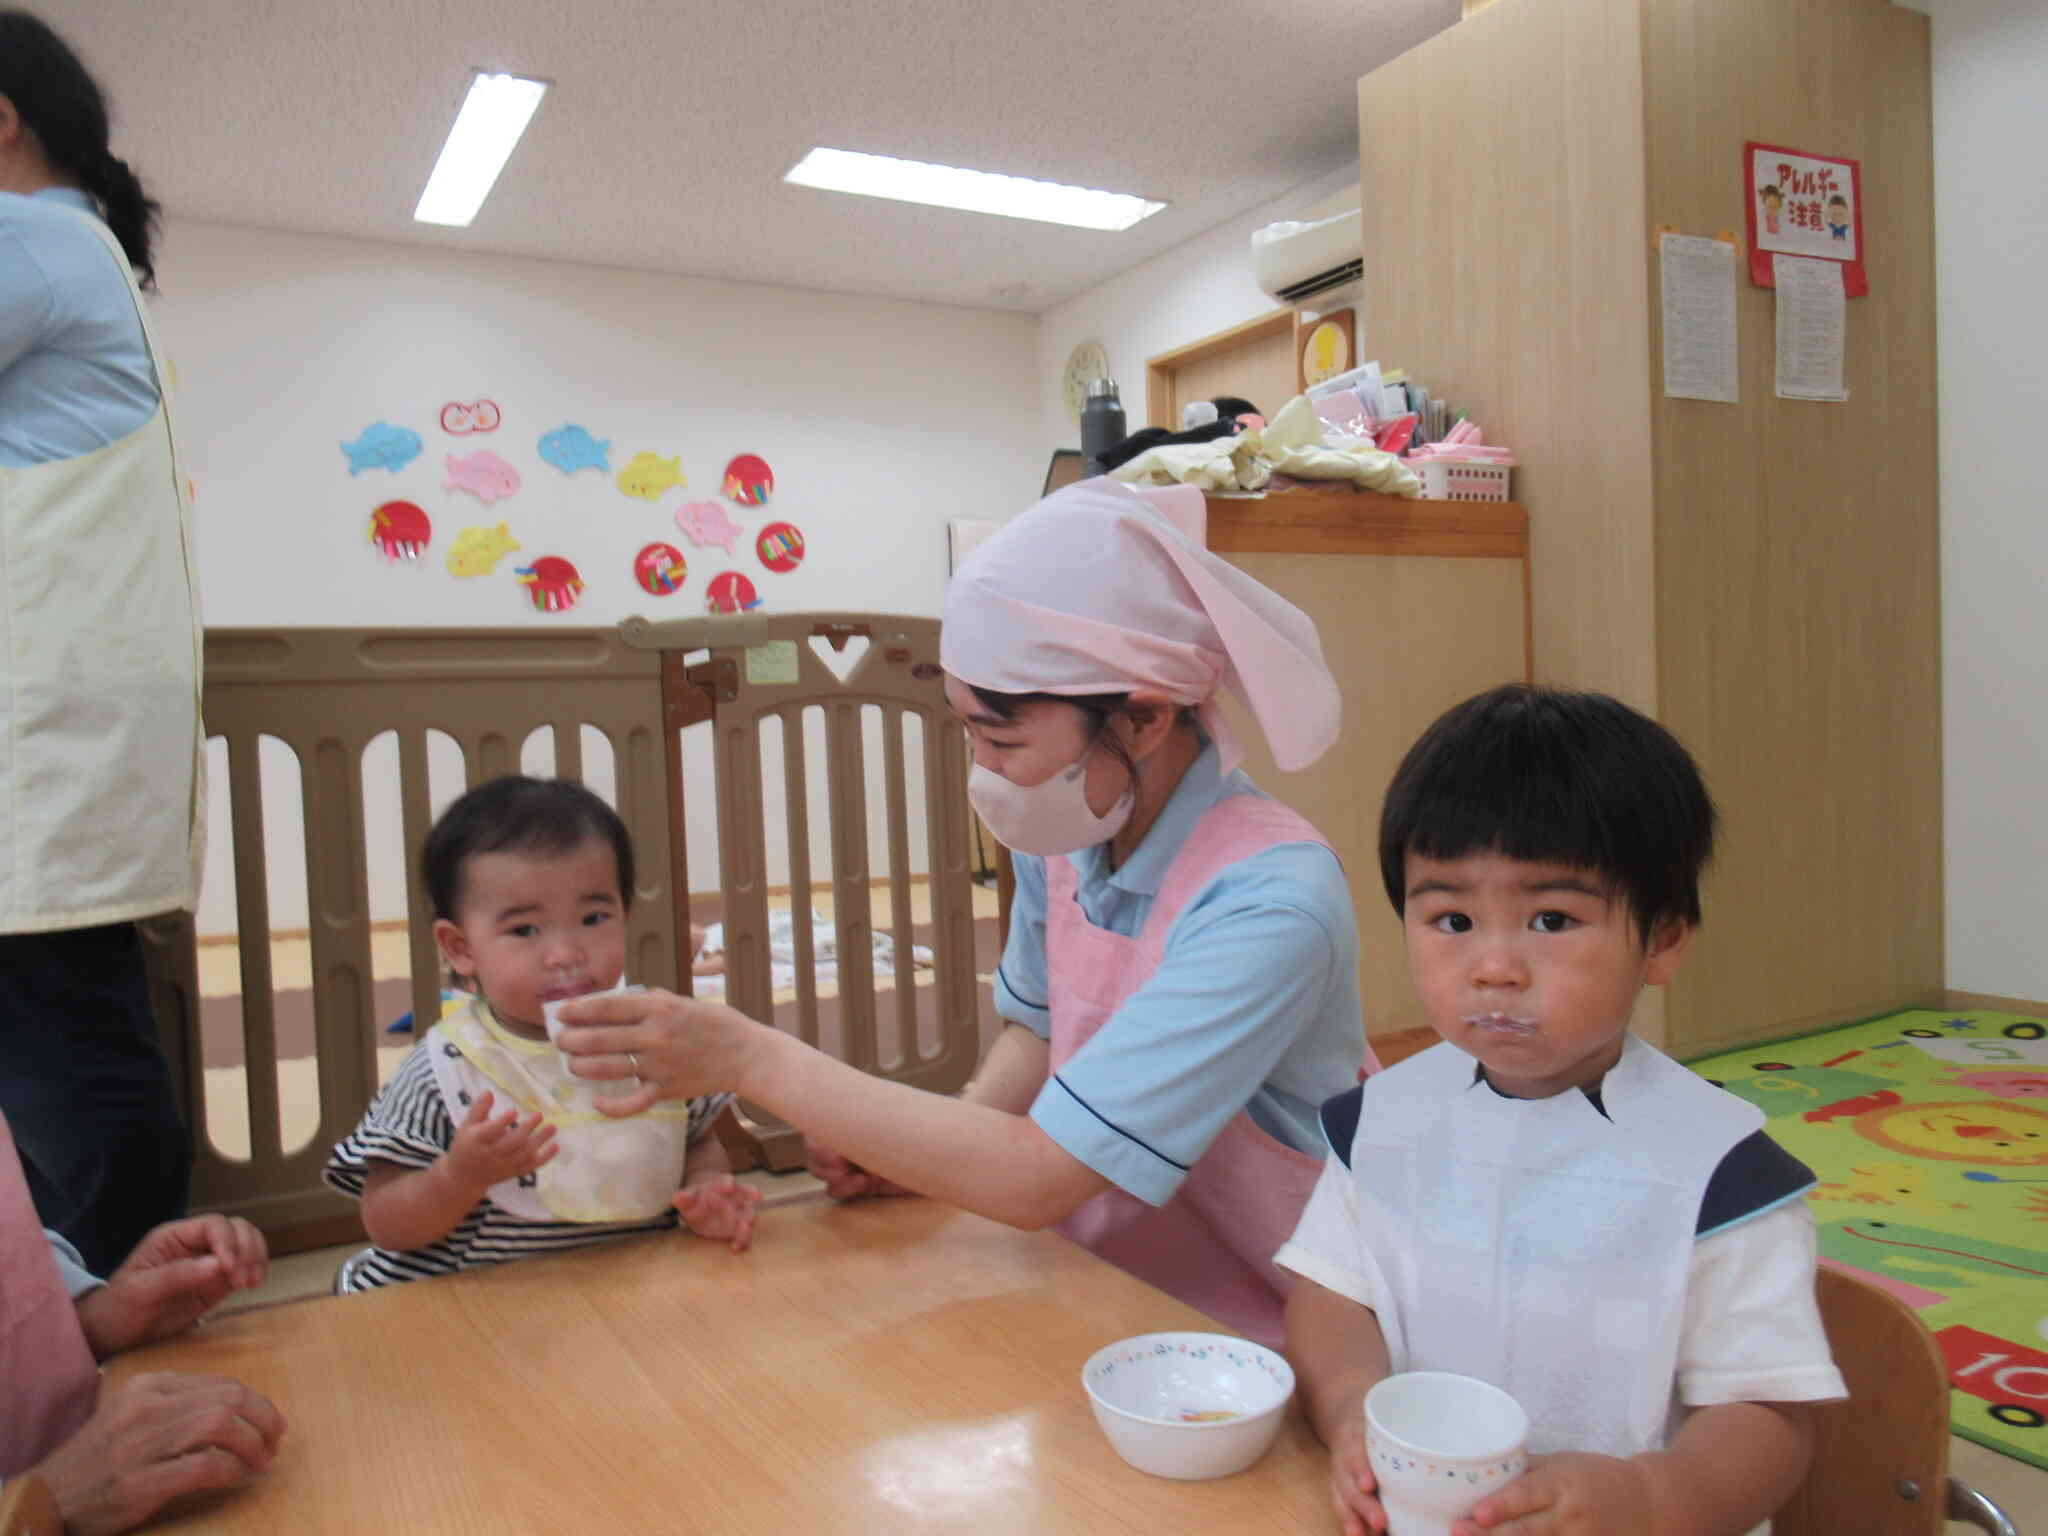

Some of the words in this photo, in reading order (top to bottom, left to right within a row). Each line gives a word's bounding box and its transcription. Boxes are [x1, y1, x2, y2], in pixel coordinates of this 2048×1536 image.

[1777, 163, 1839, 200] アレルギー
[1788, 200, 1824, 232] 注意
